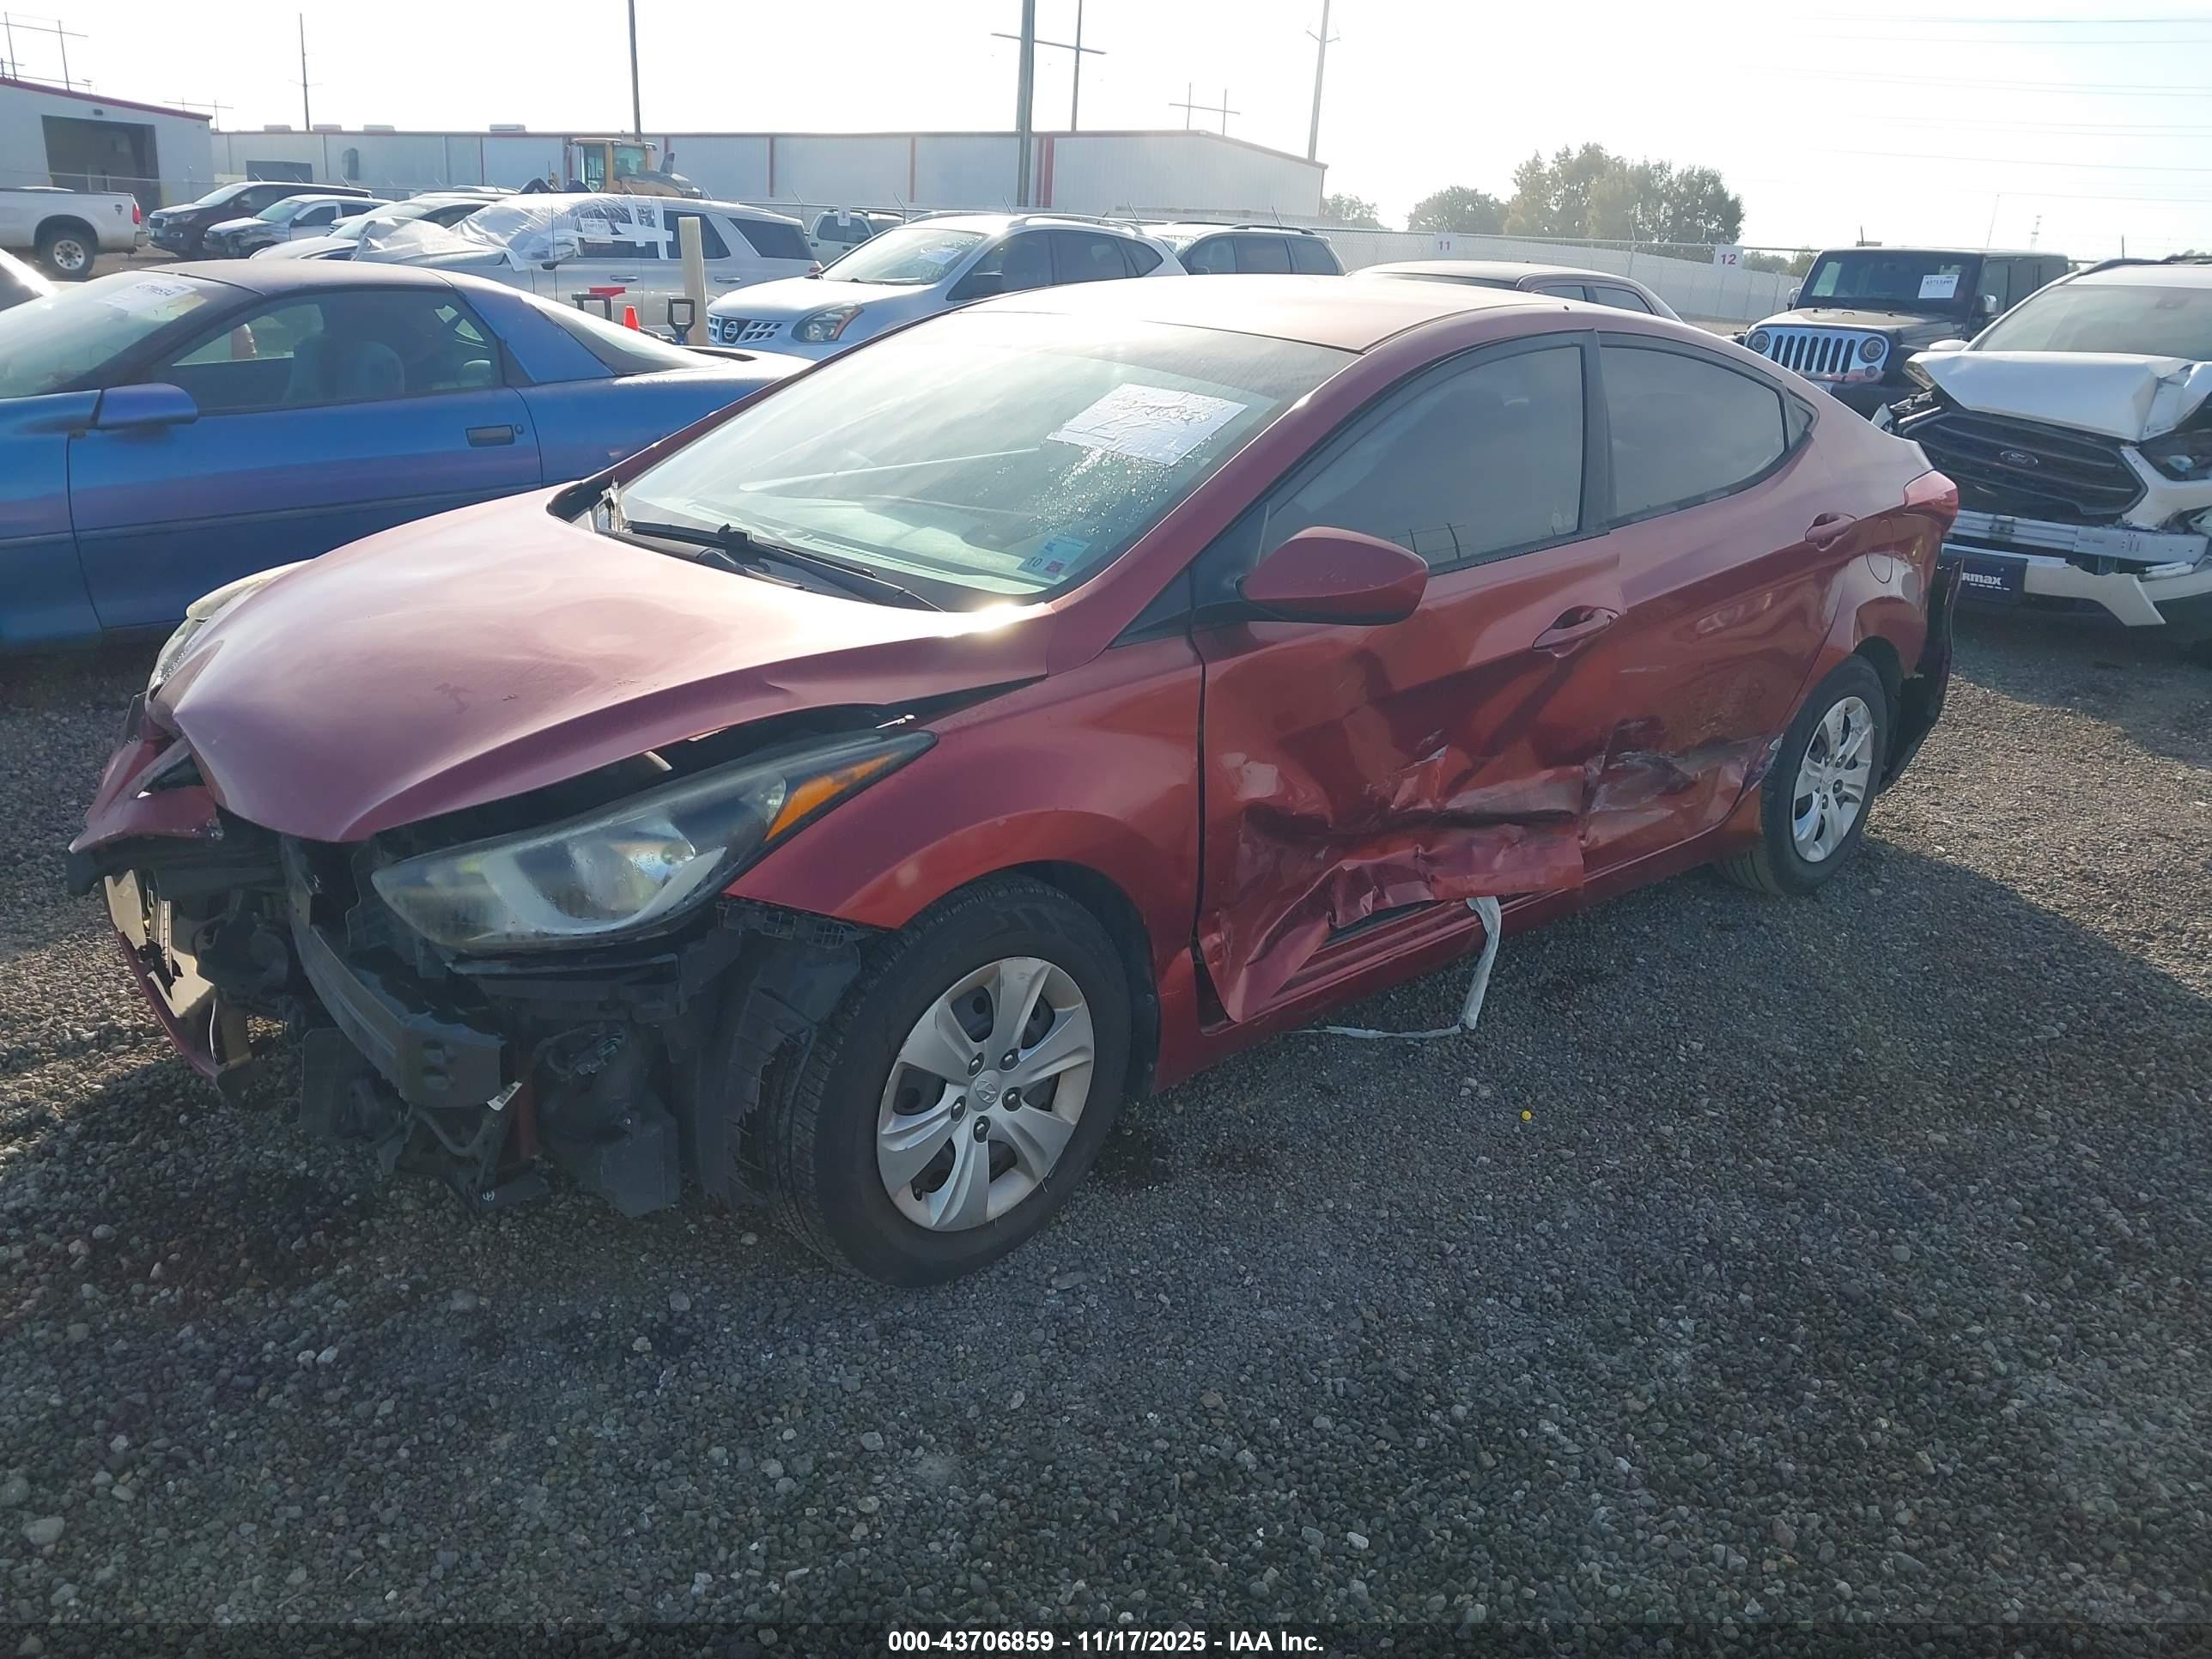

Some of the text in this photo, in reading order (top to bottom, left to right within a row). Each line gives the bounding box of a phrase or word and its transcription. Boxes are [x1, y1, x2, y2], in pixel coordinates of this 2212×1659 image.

[1438, 240, 1450, 251] 11
[1721, 253, 1737, 265] 12
[1027, 556, 1043, 568] 10
[1961, 572, 2002, 586] Rmax
